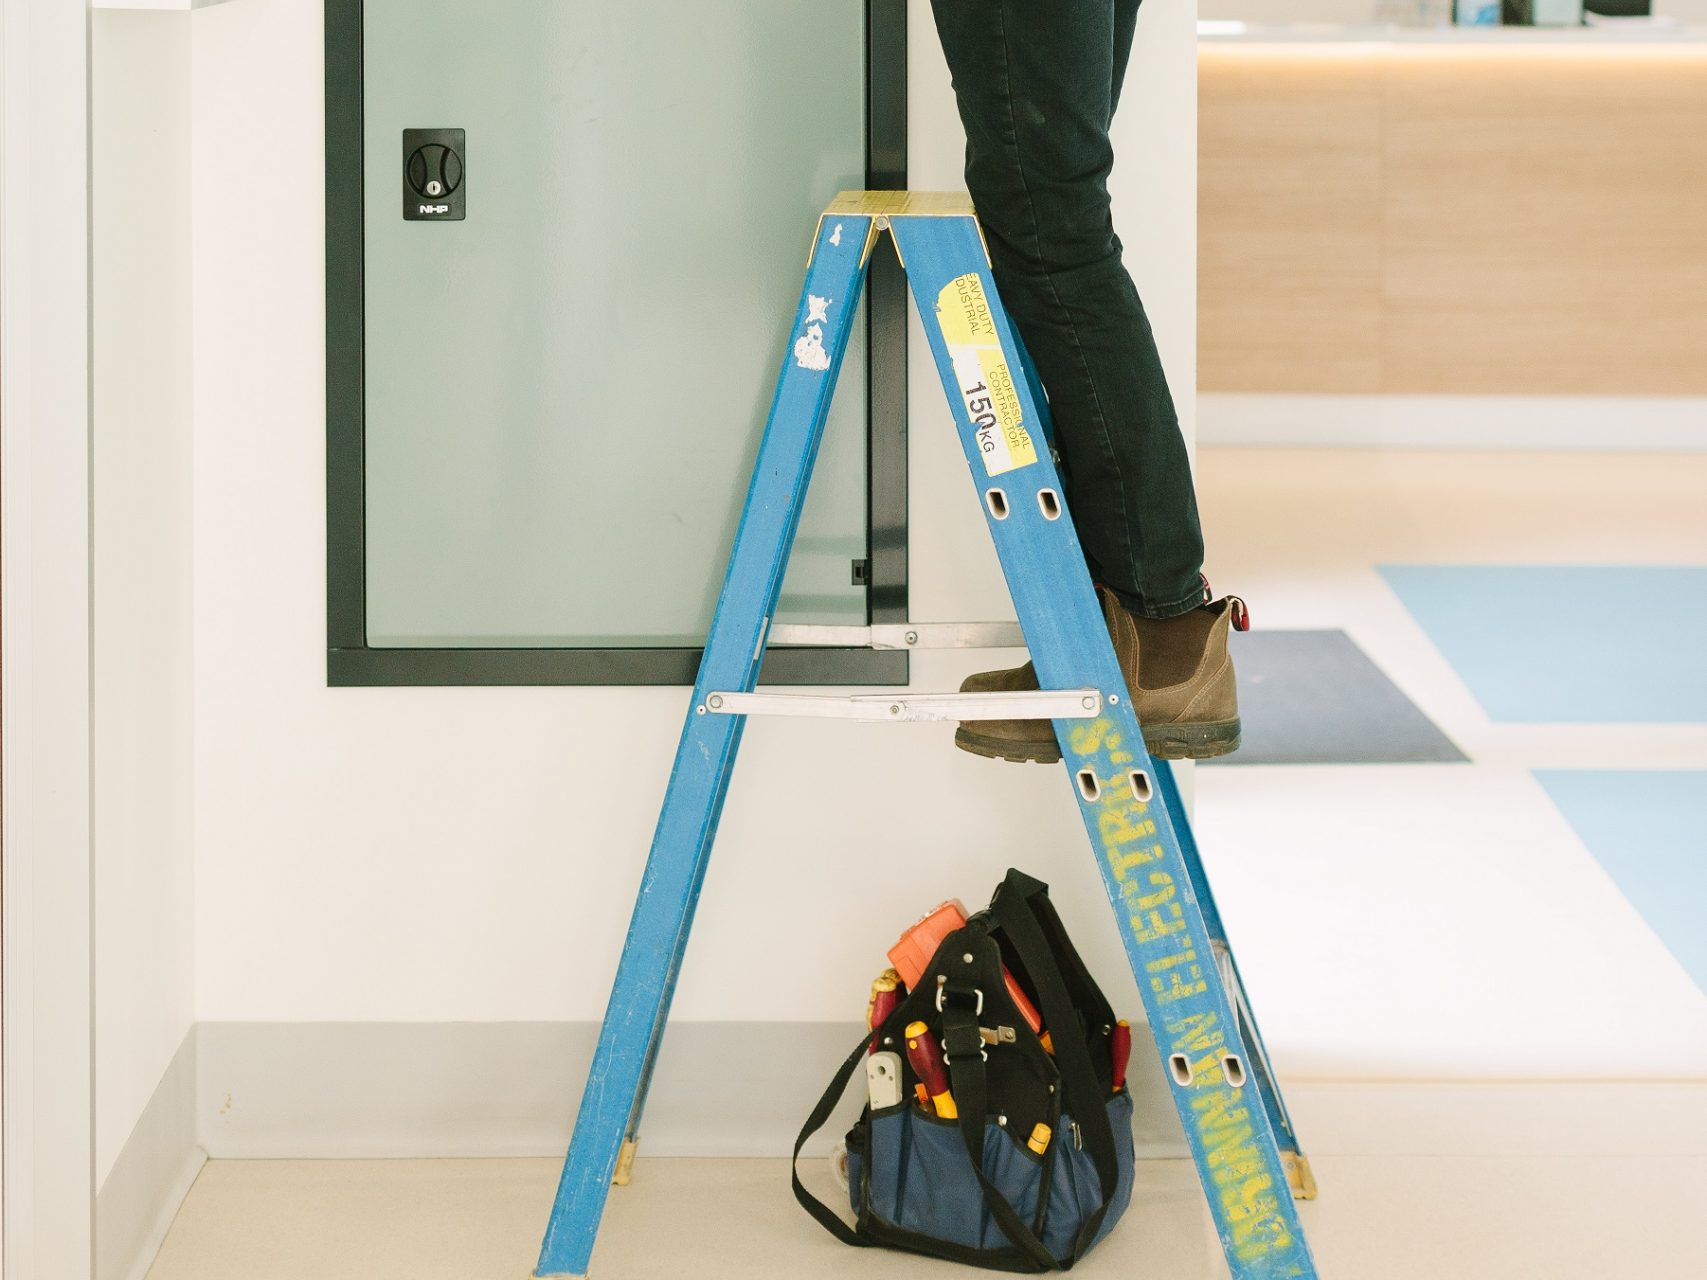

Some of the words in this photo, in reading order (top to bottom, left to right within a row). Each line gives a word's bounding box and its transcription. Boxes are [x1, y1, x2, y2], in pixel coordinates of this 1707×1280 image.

[419, 205, 449, 214] NHP
[955, 278, 980, 336] DUSTRIAL
[976, 304, 995, 335] DUTY
[989, 371, 1020, 448] CONTRACTOR
